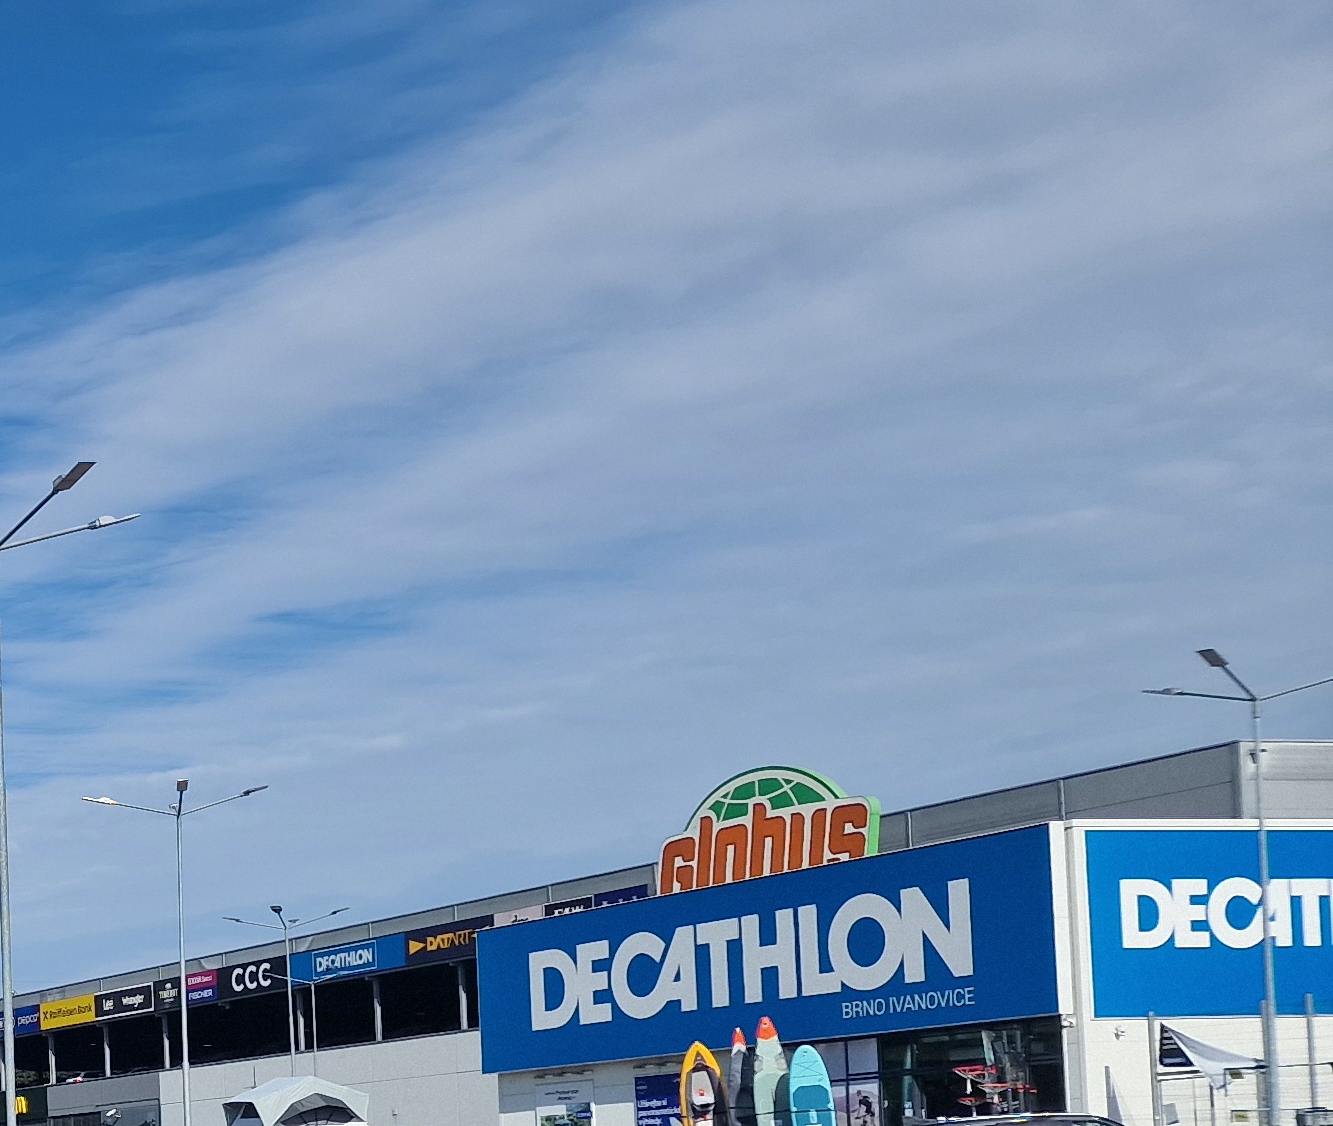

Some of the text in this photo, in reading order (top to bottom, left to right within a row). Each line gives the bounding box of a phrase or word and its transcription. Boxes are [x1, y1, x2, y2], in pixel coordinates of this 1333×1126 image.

[1119, 877, 1333, 949] DECAT
[316, 947, 373, 973] DECATHLON
[528, 877, 974, 1032] DECATHLON
[231, 963, 272, 992] CCC
[841, 986, 975, 1020] BRNO IVANOVICE
